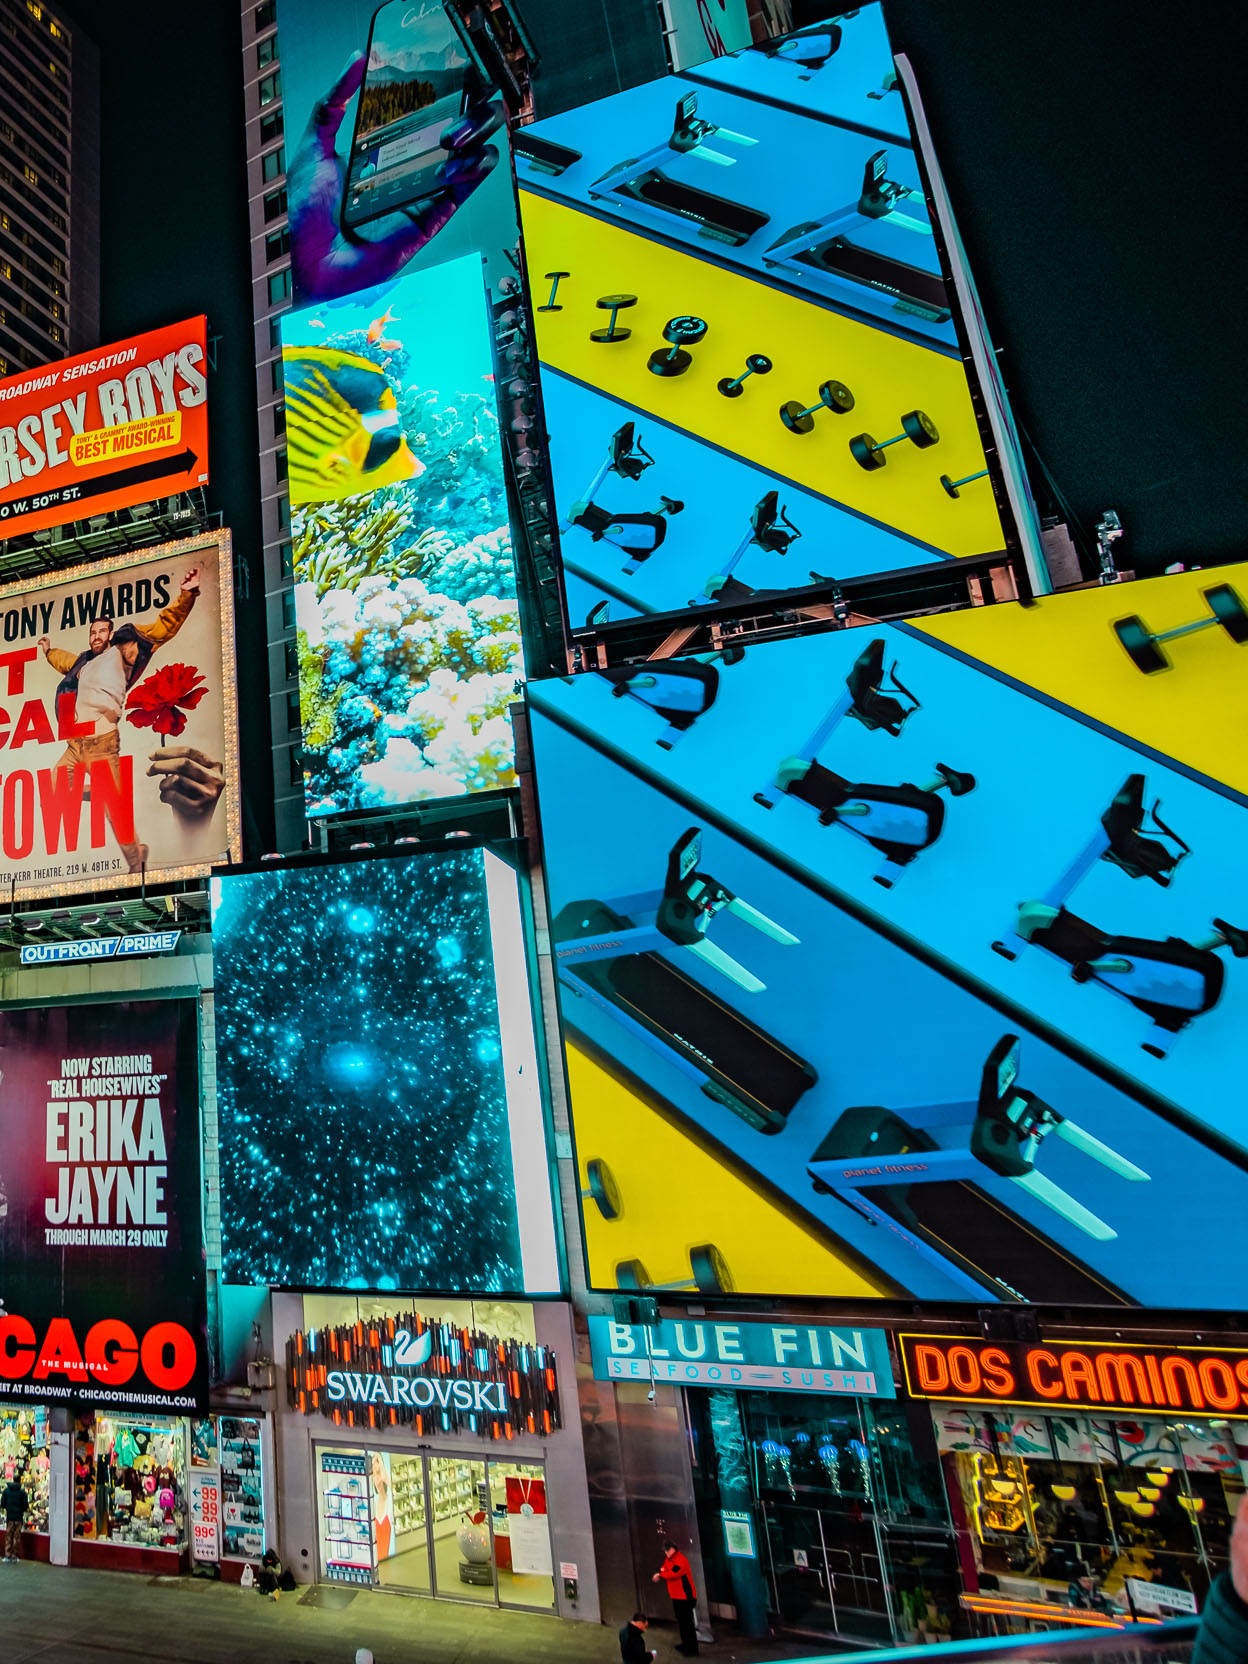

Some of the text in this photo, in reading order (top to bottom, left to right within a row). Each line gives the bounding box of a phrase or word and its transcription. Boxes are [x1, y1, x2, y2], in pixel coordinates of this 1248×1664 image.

[401, 3, 443, 28] Calm
[61, 347, 137, 382] SENSATION
[98, 343, 207, 428] BOYS
[127, 415, 176, 433] AWARD-WINNING
[75, 425, 174, 461] BEST MUSICAL
[13, 500, 29, 515] W.
[32, 492, 60, 508] 50TH
[62, 487, 82, 500] ST.
[60, 574, 171, 632] AWARDS
[14, 870, 31, 882] KERR
[66, 864, 80, 875] 219
[81, 863, 89, 873] W.
[91, 860, 110, 873] 48TH
[111, 858, 122, 870] ST.
[25, 934, 172, 960] OUTFRONT PRIME
[61, 1054, 152, 1078] NOW STARRING
[46, 1098, 168, 1162] ERIKA
[843, 1163, 929, 1179] planet fitness
[45, 1166, 168, 1225] JAYNE
[45, 1229, 168, 1247] THROUGH MARCH 29 ONLY
[608, 1321, 868, 1368] BLUE FIN
[41, 1360, 109, 1371] THE MUSICAL
[613, 1361, 872, 1390] SEAFOOD SUSHI
[914, 1344, 1015, 1396] DOS
[12, 1383, 23, 1393] AT
[24, 1385, 72, 1398] BROADWAY
[79, 1388, 196, 1408] CHICAGOTHEMUSICAL.COM
[326, 1371, 508, 1412] SWAROVSKI
[201, 1487, 218, 1501] 99
[202, 1501, 218, 1516] 99
